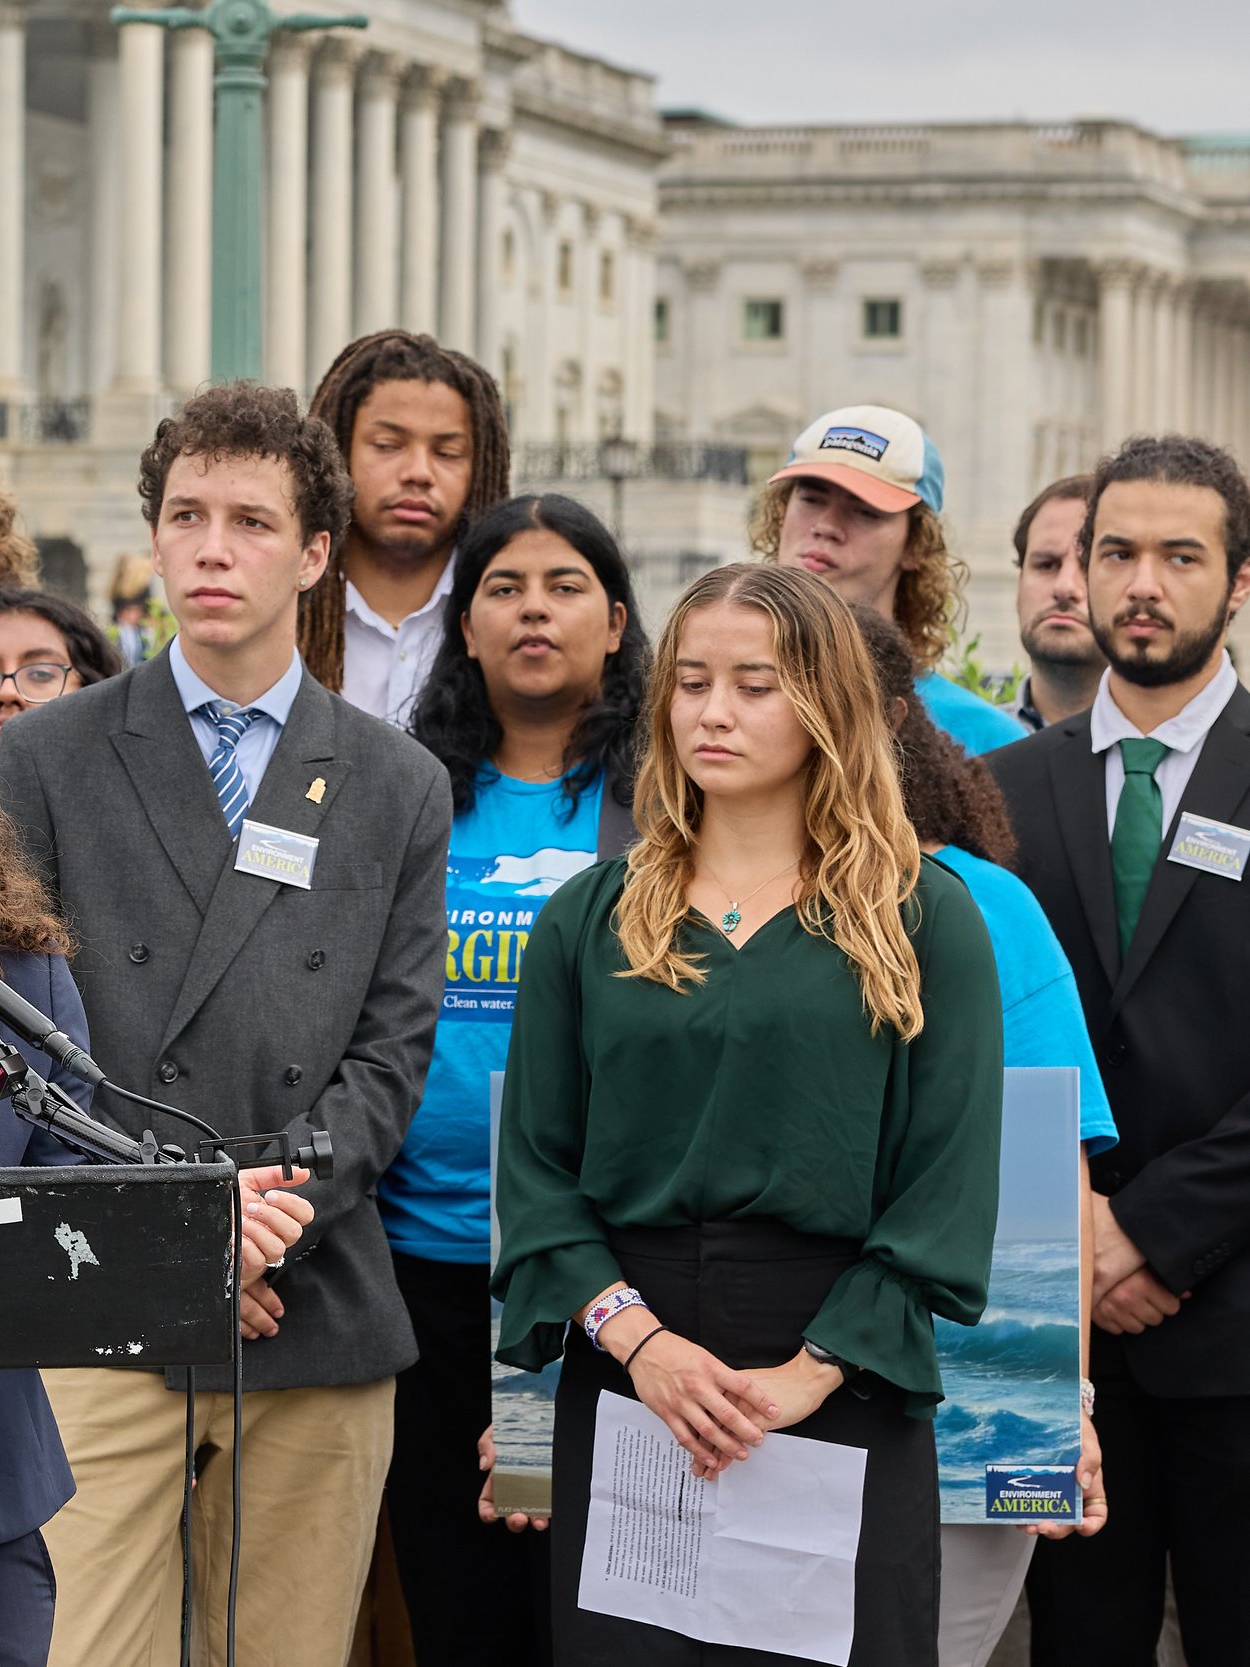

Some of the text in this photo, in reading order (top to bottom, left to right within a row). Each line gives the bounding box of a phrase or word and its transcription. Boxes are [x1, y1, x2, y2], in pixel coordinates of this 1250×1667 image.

[251, 844, 304, 864] ENVIRONMENT
[1175, 841, 1241, 870] AMERICA
[243, 849, 309, 877] AMERICA
[443, 995, 515, 1010] Clean water.
[1000, 1490, 1062, 1499] ENVIRONMENT
[990, 1499, 1071, 1513] AMERICA
